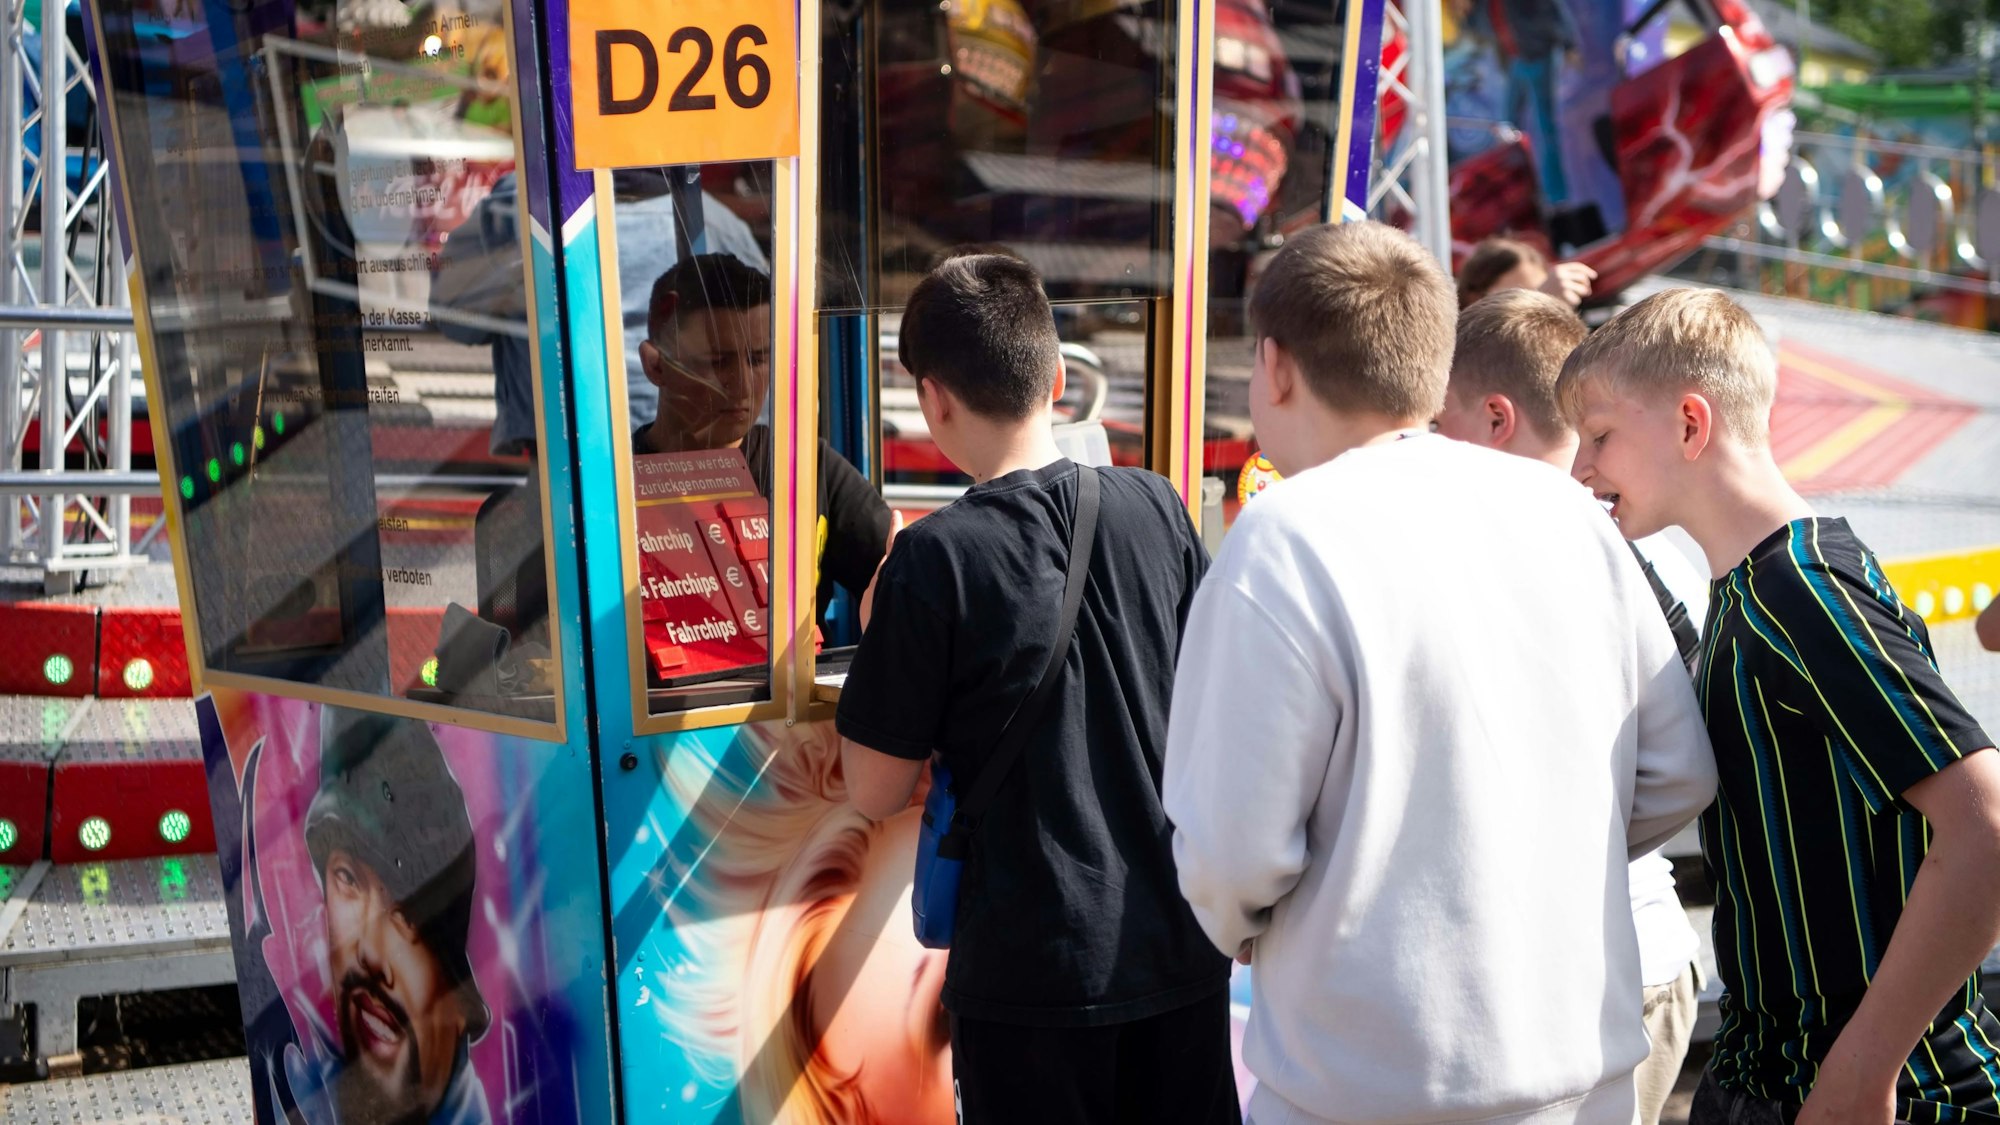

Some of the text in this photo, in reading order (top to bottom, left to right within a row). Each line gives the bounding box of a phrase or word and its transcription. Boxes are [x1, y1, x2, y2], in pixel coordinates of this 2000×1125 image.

[440, 14, 478, 33] Armen
[595, 24, 771, 115] D26
[360, 195, 374, 209] zu
[375, 187, 447, 208] übernehmen,
[369, 309, 386, 325] der
[388, 306, 421, 325] Kasse
[635, 455, 740, 476] Fahrchips werden
[638, 474, 741, 496] zurückgenommen
[637, 528, 694, 554] ahrchip
[708, 523, 726, 545] €
[386, 566, 432, 586] verboten
[650, 573, 719, 600] Fahrchips
[726, 566, 744, 588] €
[666, 609, 761, 645] Fahrchips €
